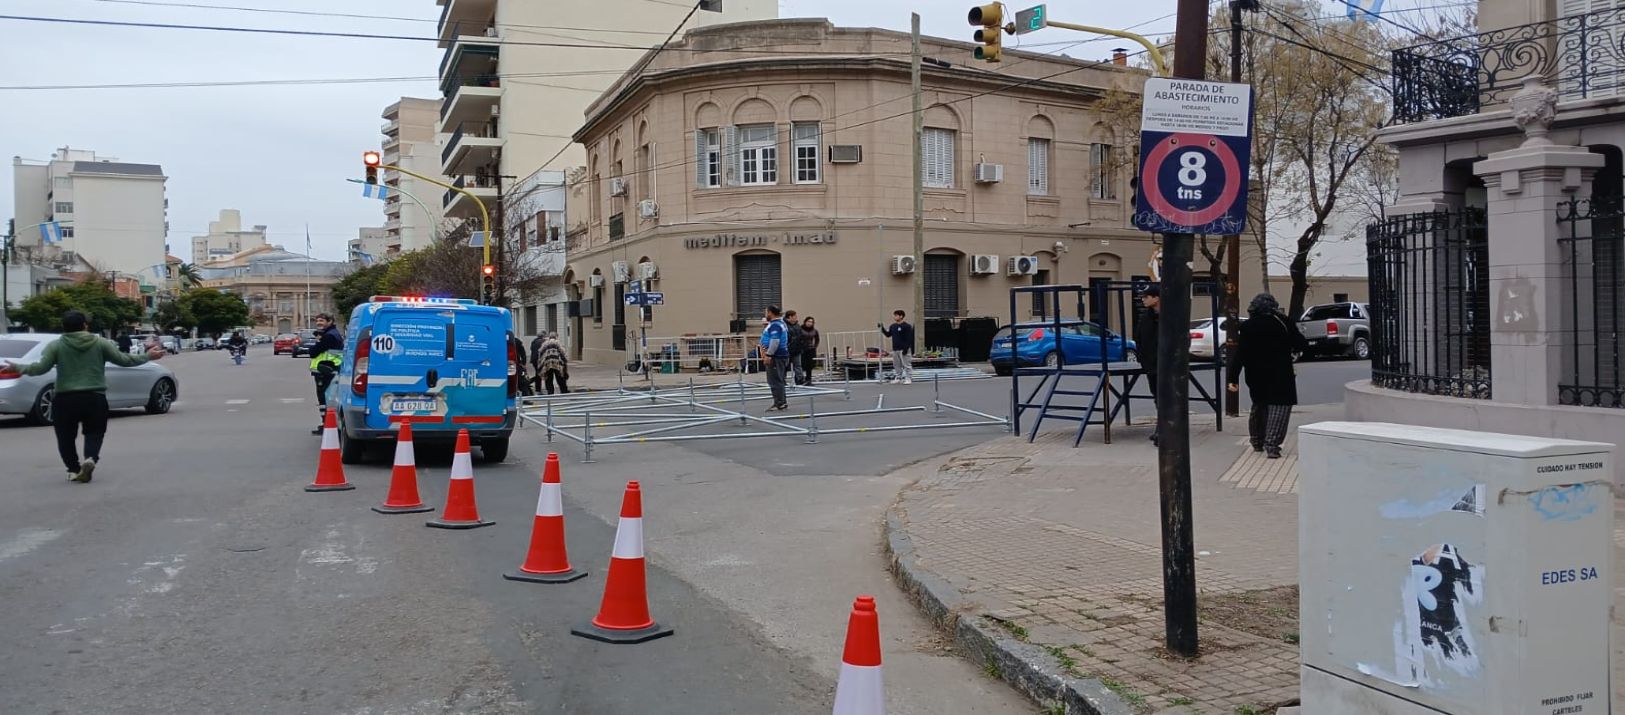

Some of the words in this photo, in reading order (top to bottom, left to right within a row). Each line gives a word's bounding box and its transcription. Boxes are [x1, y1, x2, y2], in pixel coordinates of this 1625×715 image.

[1030, 6, 1042, 31] 2
[1170, 82, 1209, 93] PARADA
[1212, 85, 1225, 94] DE
[1155, 91, 1239, 104] ABASTECIMIENTO
[1178, 151, 1206, 186] 8
[1177, 186, 1202, 200] tns
[684, 233, 768, 249] medifem
[782, 231, 838, 246] imad
[374, 336, 393, 351] 110
[1537, 464, 1564, 473] CUIDADO
[1578, 462, 1603, 470] TENSION
[1542, 569, 1576, 585] EDES
[1580, 567, 1598, 580] SA
[1542, 695, 1574, 706] PROHIBIDO
[1576, 691, 1593, 700] FIJAR
[1553, 705, 1583, 715] CARTELES
